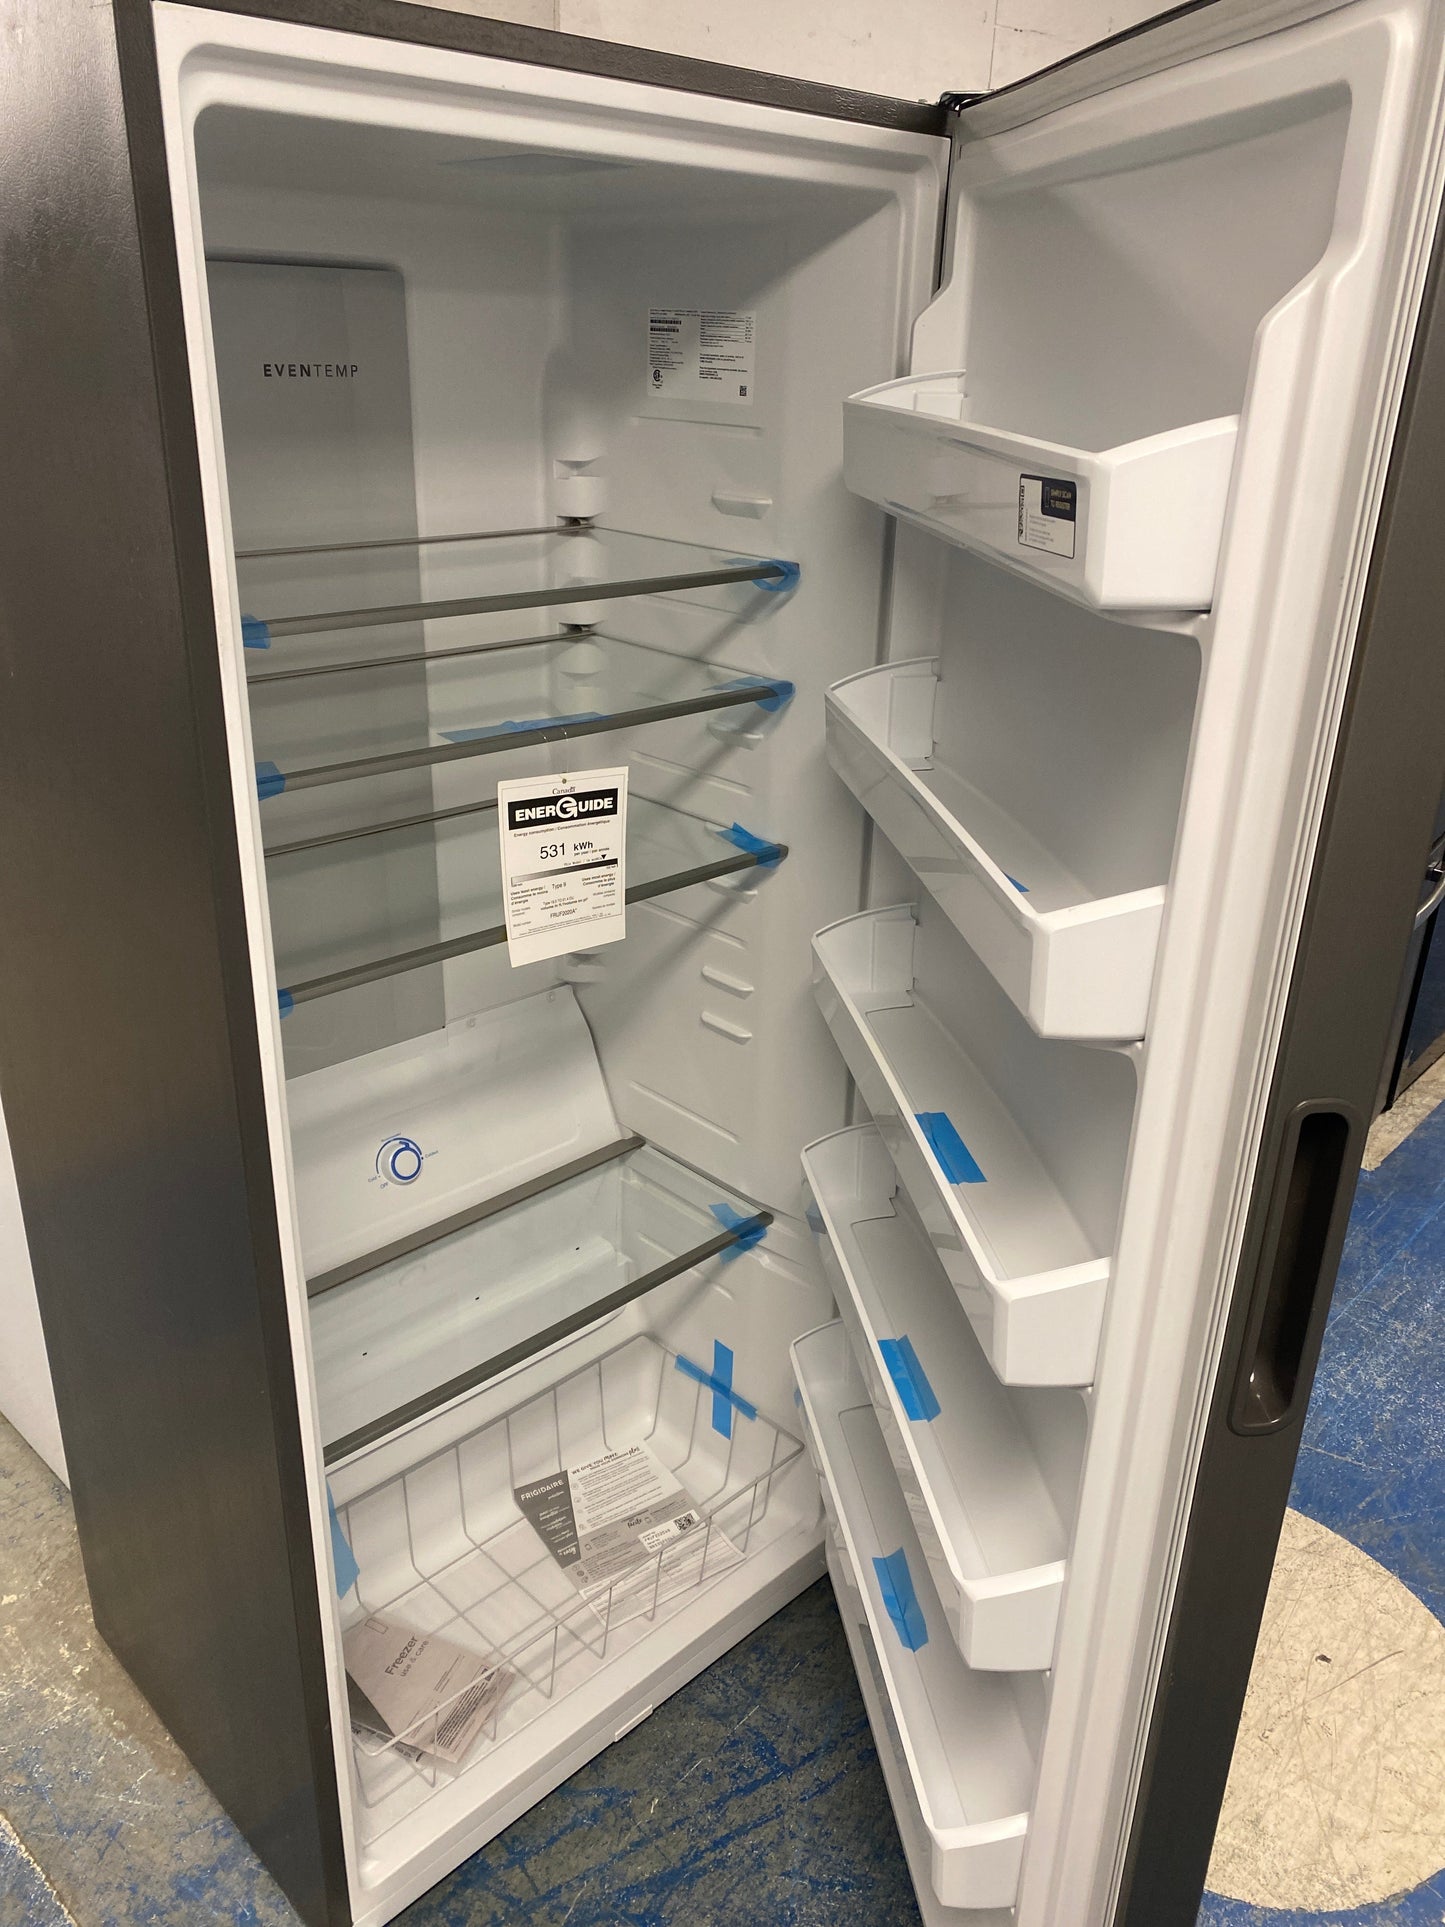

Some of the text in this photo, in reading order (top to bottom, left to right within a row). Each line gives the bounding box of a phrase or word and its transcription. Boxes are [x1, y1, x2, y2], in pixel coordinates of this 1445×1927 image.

[263, 363, 358, 378] EVENTEMP
[515, 796, 614, 822] ENERGUIDE
[539, 841, 594, 860] 531 kWh
[520, 1479, 565, 1502] FRIGIDAIRE
[384, 1635, 418, 1676] Freezer
[400, 1663, 411, 1677] use
[415, 1640, 429, 1656] care
